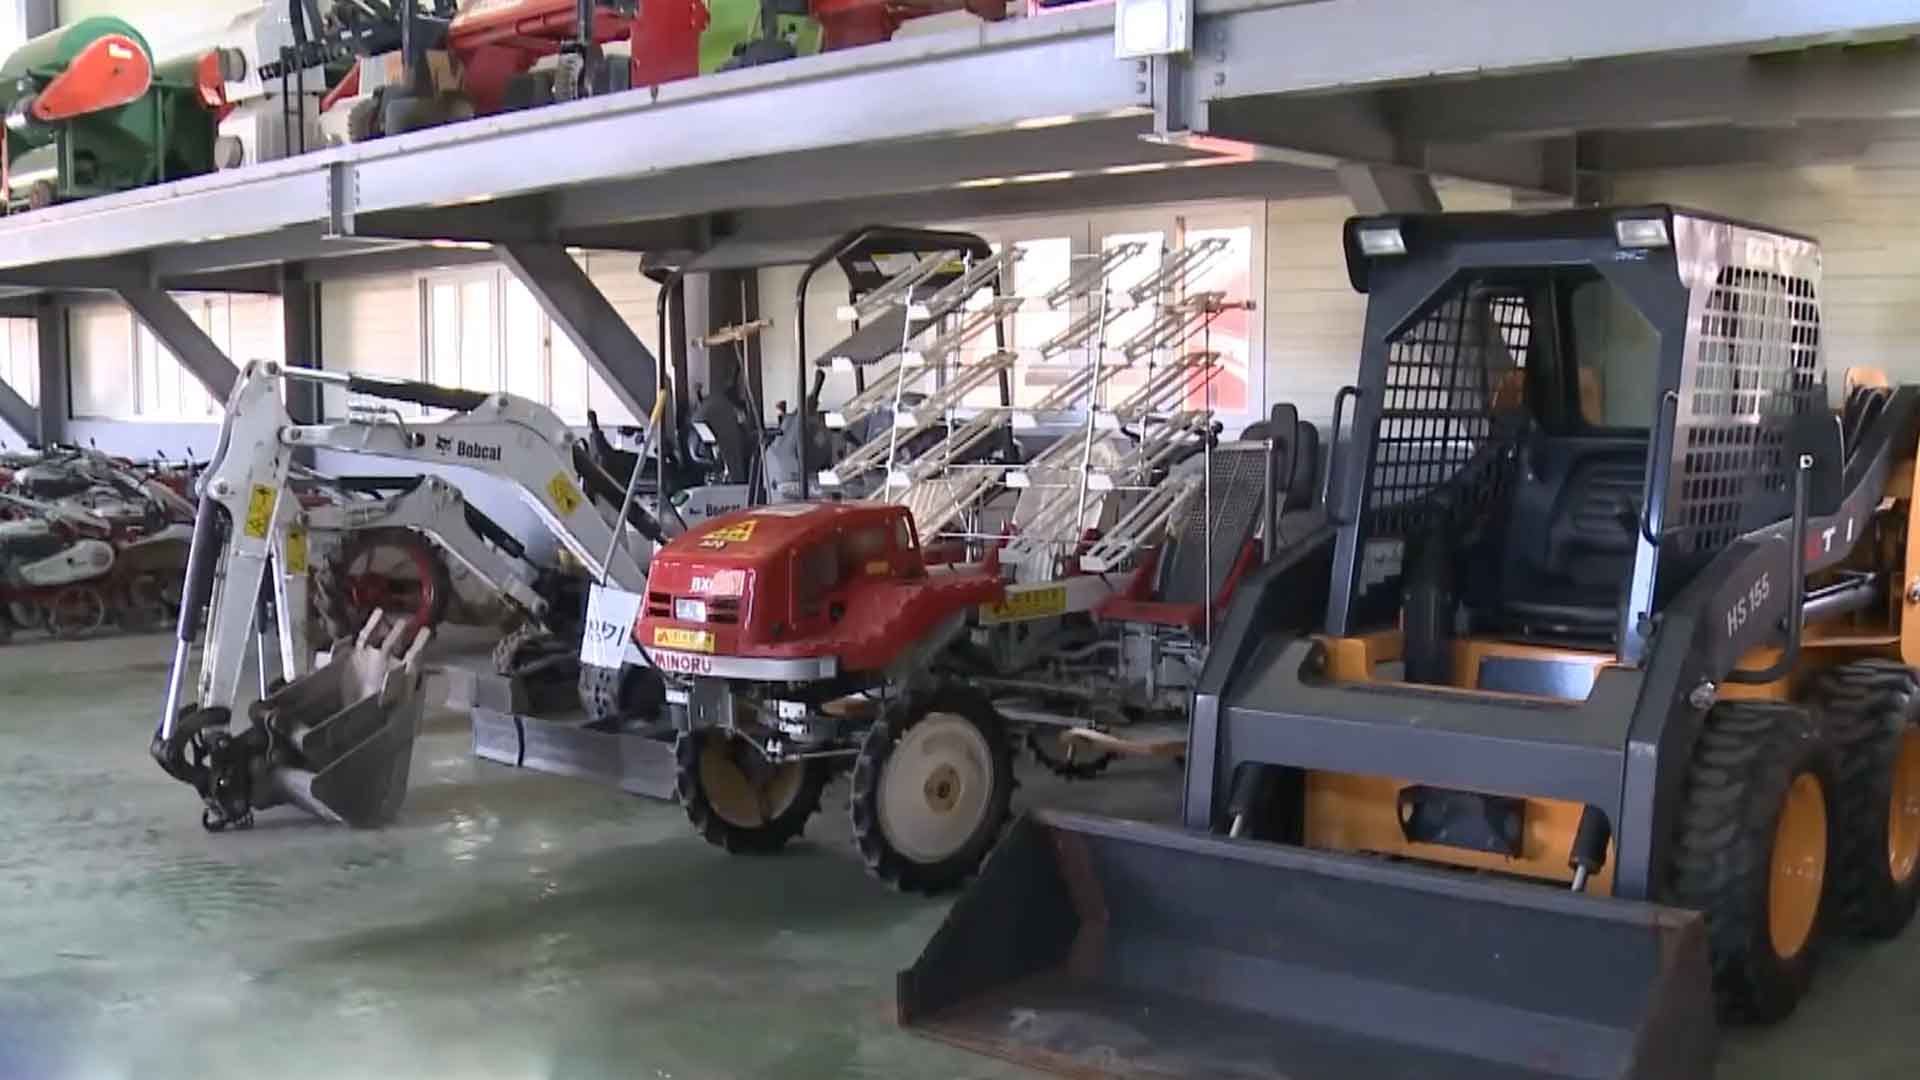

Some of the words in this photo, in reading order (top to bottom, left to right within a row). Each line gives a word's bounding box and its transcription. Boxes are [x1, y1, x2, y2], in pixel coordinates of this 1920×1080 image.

[457, 440, 501, 461] Bobcat
[1726, 597, 1747, 638] HS
[1749, 571, 1770, 614] 155
[655, 651, 712, 673] MINORU
